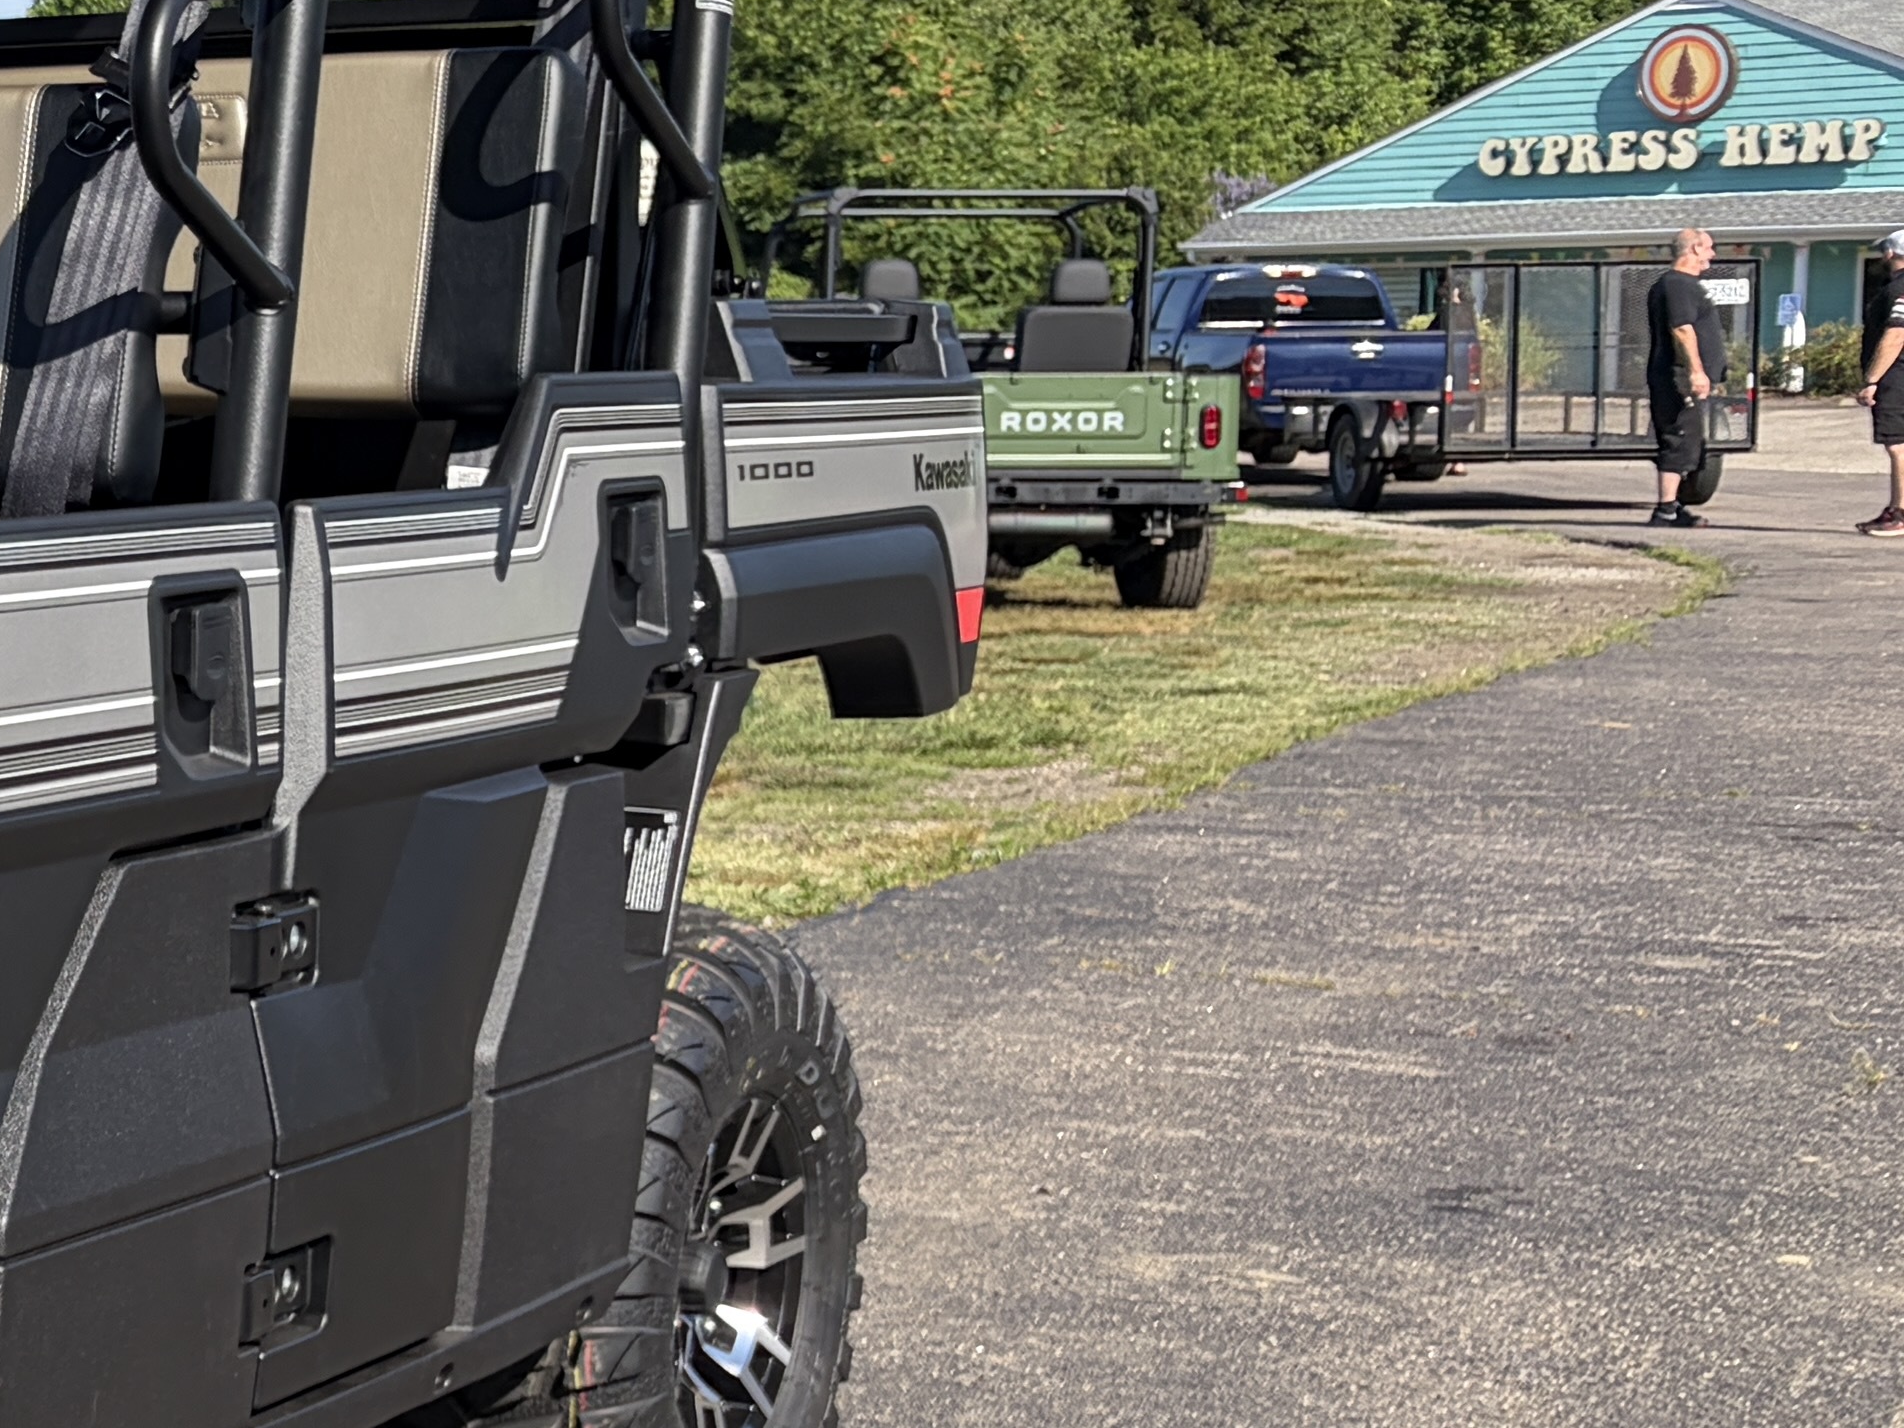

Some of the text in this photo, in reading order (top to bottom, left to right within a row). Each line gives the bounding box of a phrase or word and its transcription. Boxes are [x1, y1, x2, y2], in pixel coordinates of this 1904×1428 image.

[1478, 118, 1885, 177] CYPRESS HEMP
[1000, 411, 1125, 432] ROXOR
[737, 449, 978, 492] 1000 Kawasaki
